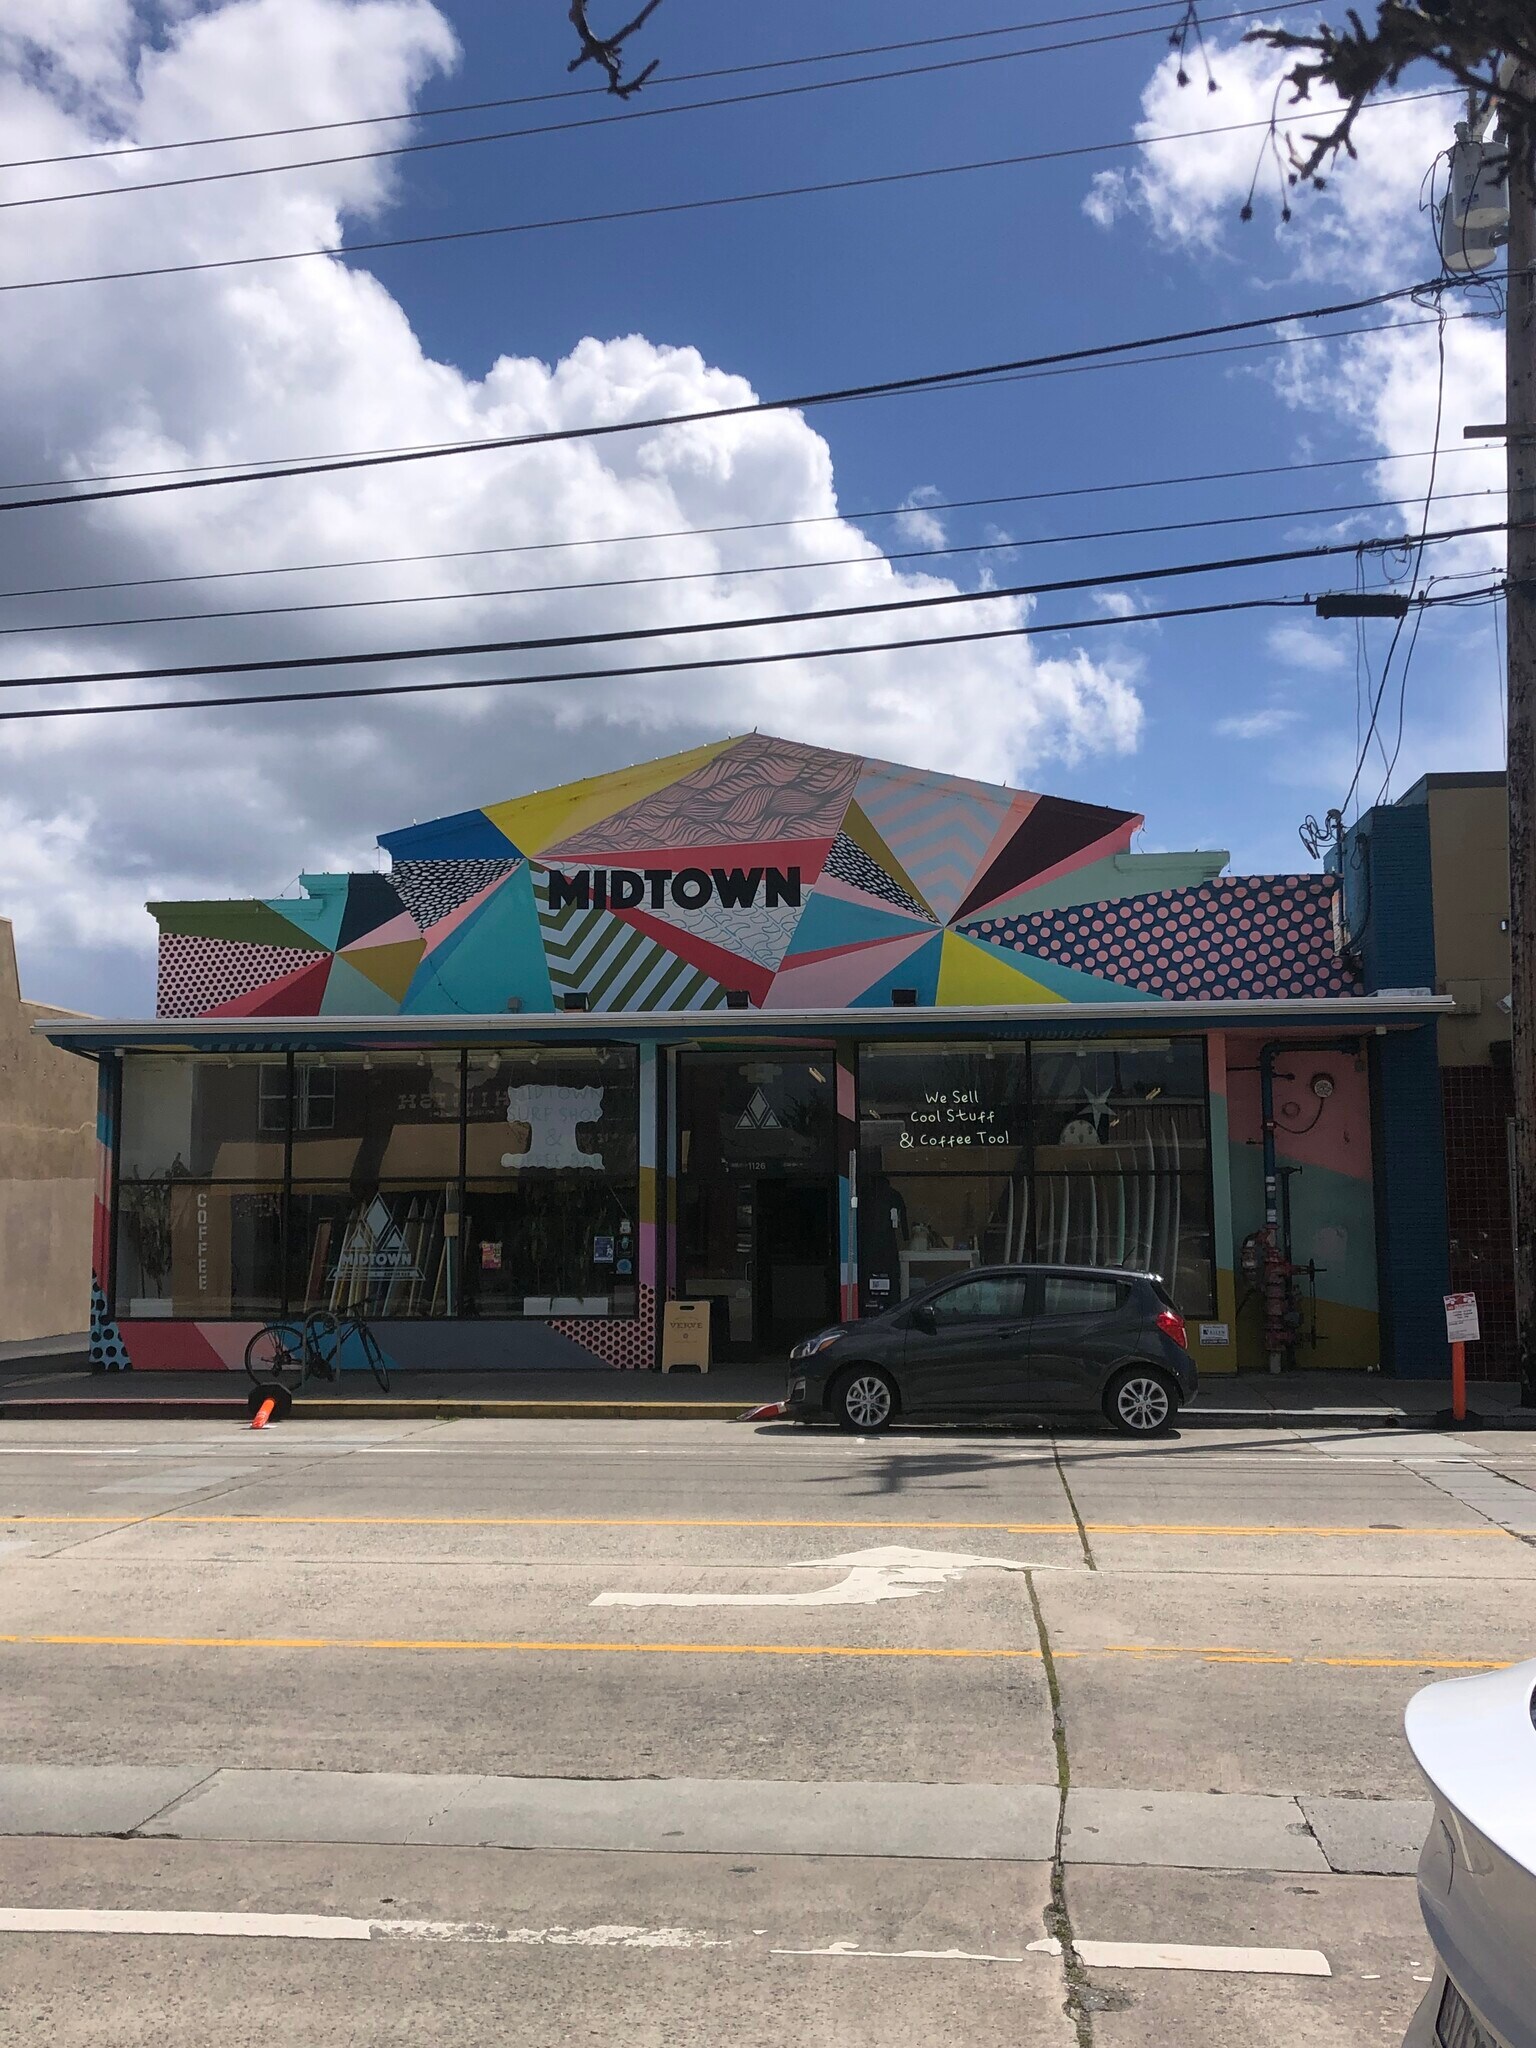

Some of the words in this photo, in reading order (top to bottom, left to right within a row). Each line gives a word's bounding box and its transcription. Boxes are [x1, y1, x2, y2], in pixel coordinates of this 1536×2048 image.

[549, 867, 801, 911] MIDTOWN
[924, 1092, 948, 1104] We
[952, 1090, 979, 1104] Sell
[910, 1110, 941, 1123] Cool
[946, 1109, 995, 1124] Stuff
[545, 1128, 562, 1146] &
[899, 1132, 914, 1149] &
[919, 1134, 972, 1148] Coffee
[748, 1162, 766, 1171] 1126
[197, 1193, 207, 1291] COFFEE
[340, 1253, 412, 1267] MIDTOWN
[670, 1321, 703, 1330] VERVE
